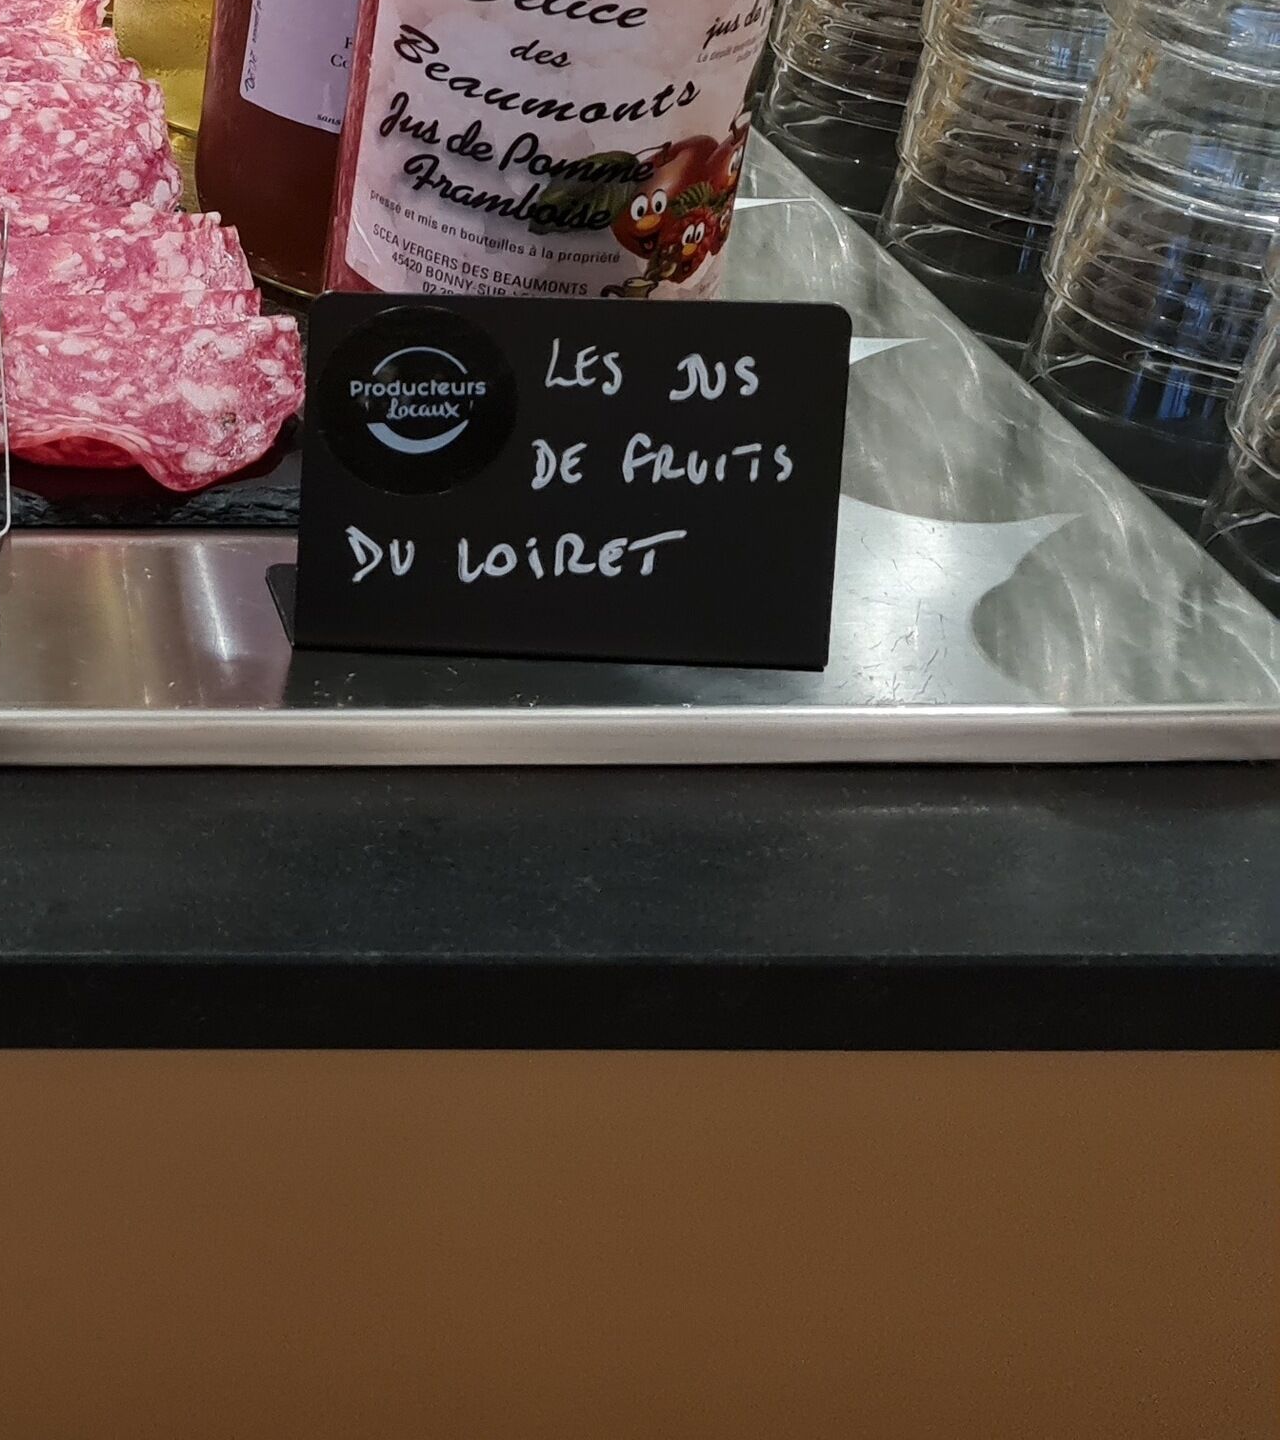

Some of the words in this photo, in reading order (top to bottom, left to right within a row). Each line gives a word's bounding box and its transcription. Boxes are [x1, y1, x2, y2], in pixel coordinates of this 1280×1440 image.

[510, 40, 572, 68] des
[703, 13, 740, 50] jus
[393, 24, 700, 124] Beaumonts
[379, 91, 441, 144] Jus
[445, 120, 494, 162] de
[500, 132, 655, 186] Pomme
[403, 154, 613, 231] Framboise
[370, 189, 402, 215] pressé
[404, 208, 416, 221] et
[418, 215, 438, 230] mis
[441, 224, 457, 237] en
[460, 229, 525, 256] bouteilles
[529, 243, 538, 257] à
[541, 246, 553, 259] la
[373, 223, 400, 247] SCEA
[402, 239, 458, 271] VERGERS
[462, 262, 489, 280] DES
[493, 270, 589, 295] BEAUMONTS
[391, 252, 423, 274] 45420
[350, 379, 487, 397] Producteurs
[545, 337, 623, 395] LES
[669, 353, 760, 401] JUS
[531, 437, 588, 490] DE
[622, 432, 794, 485] FRUITS
[345, 525, 416, 583] DU
